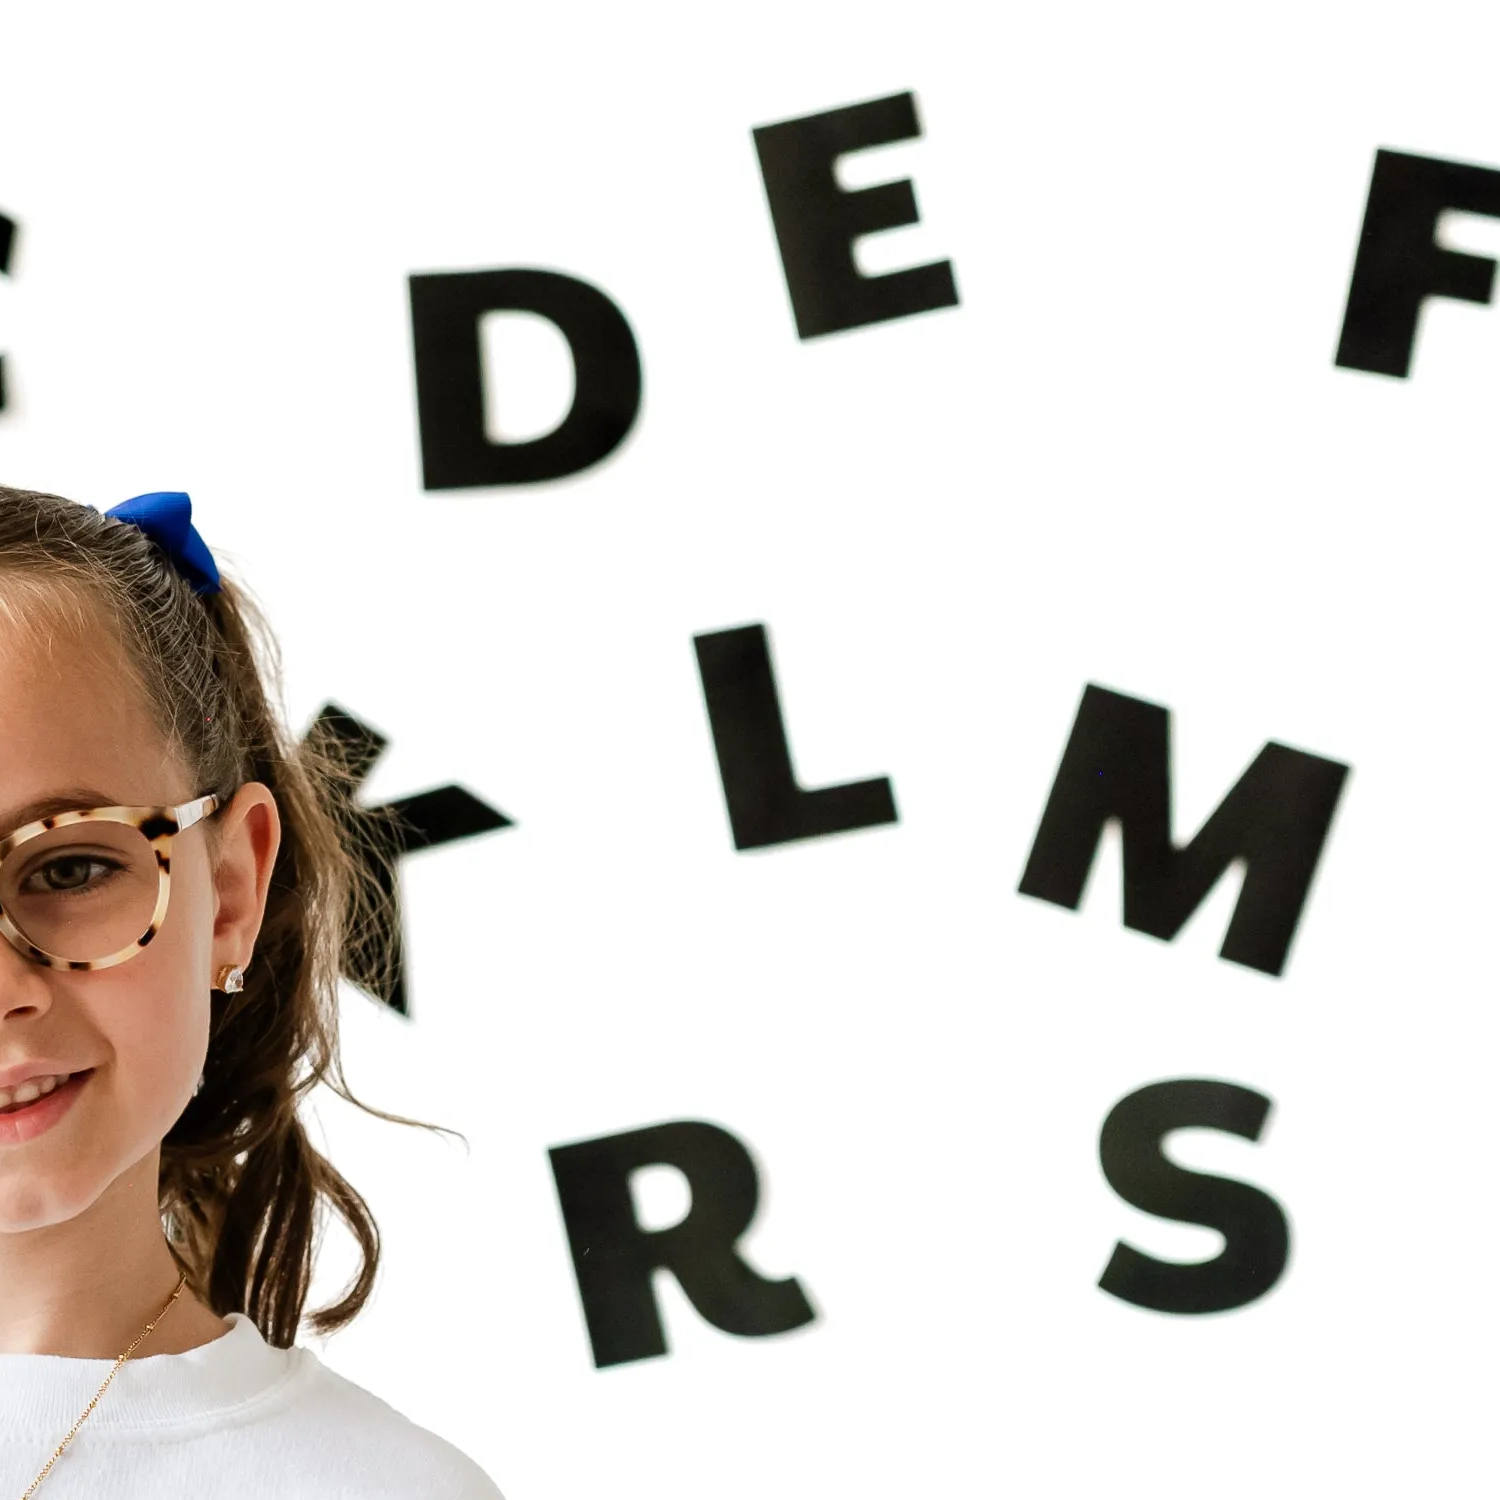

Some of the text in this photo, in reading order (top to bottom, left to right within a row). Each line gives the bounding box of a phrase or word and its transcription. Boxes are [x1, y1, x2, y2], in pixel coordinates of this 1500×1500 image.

[409, 269, 641, 490] D
[753, 92, 958, 339] E
[1335, 150, 1500, 378] F
[694, 624, 897, 850] L
[1019, 684, 1349, 976] M
[549, 1122, 814, 1368] R
[1099, 1080, 1288, 1314] S
